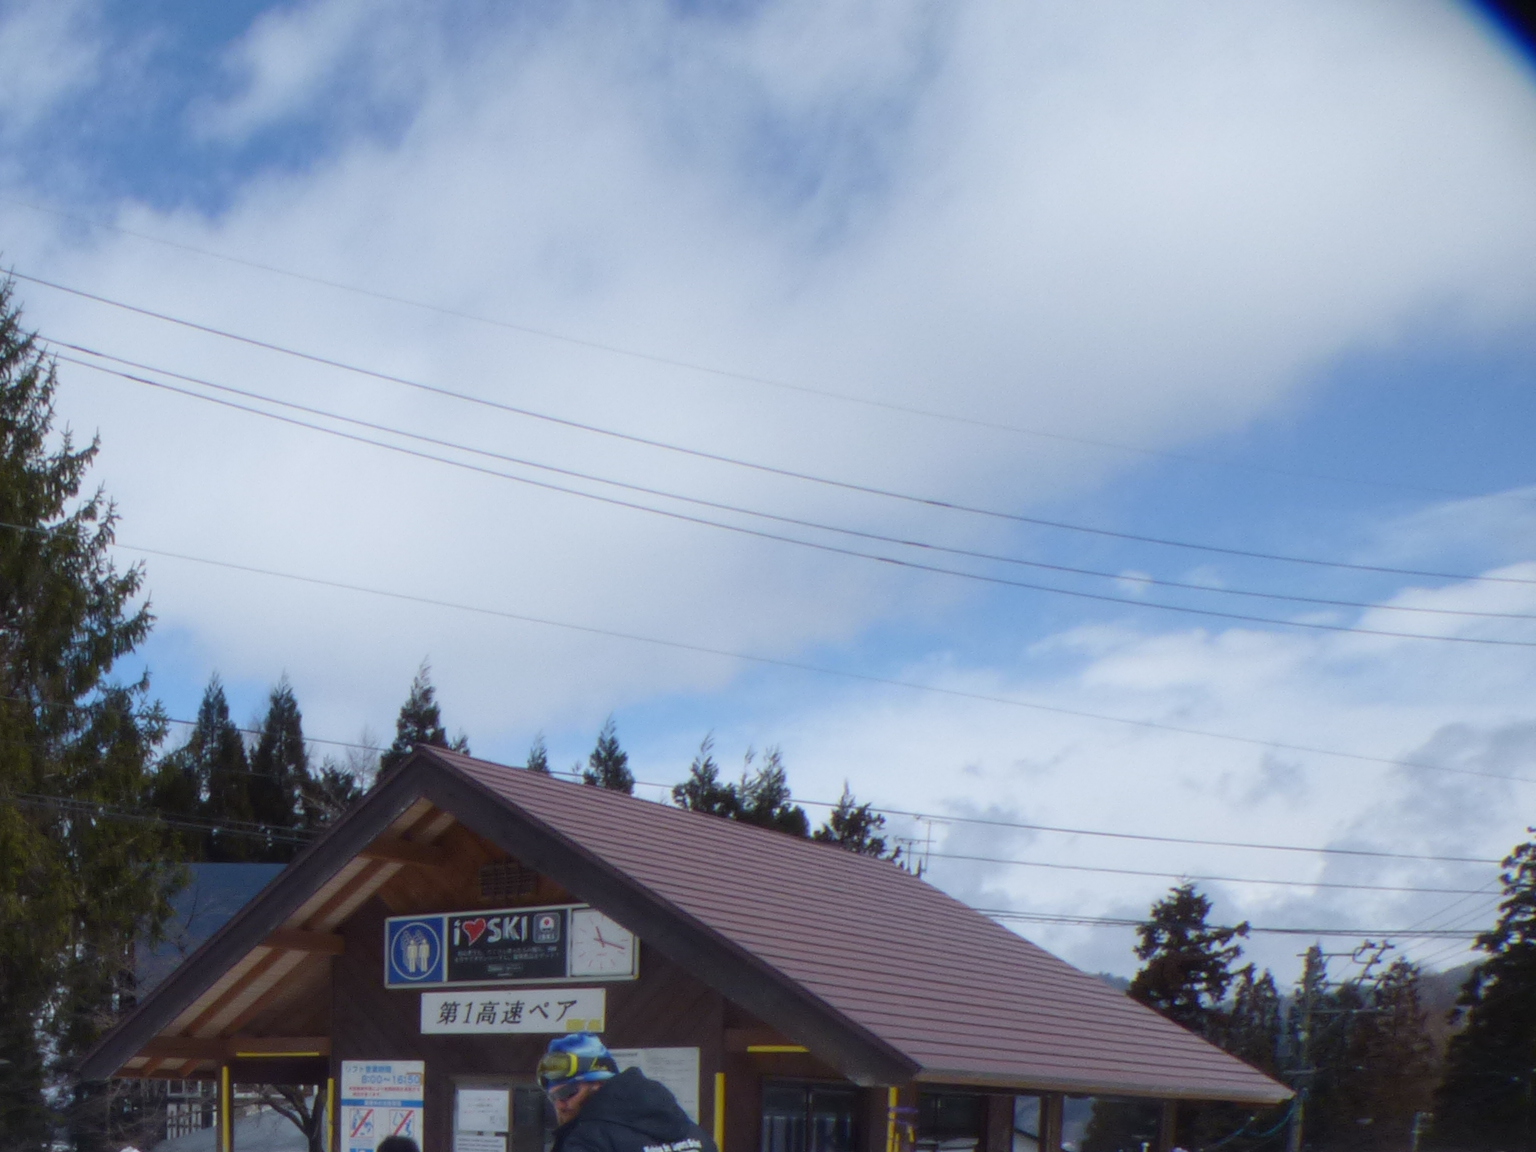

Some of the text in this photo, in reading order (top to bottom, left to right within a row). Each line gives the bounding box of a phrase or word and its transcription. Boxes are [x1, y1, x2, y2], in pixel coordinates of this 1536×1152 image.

[486, 915, 528, 943] SKI
[437, 1000, 578, 1025] 第1高速ペア
